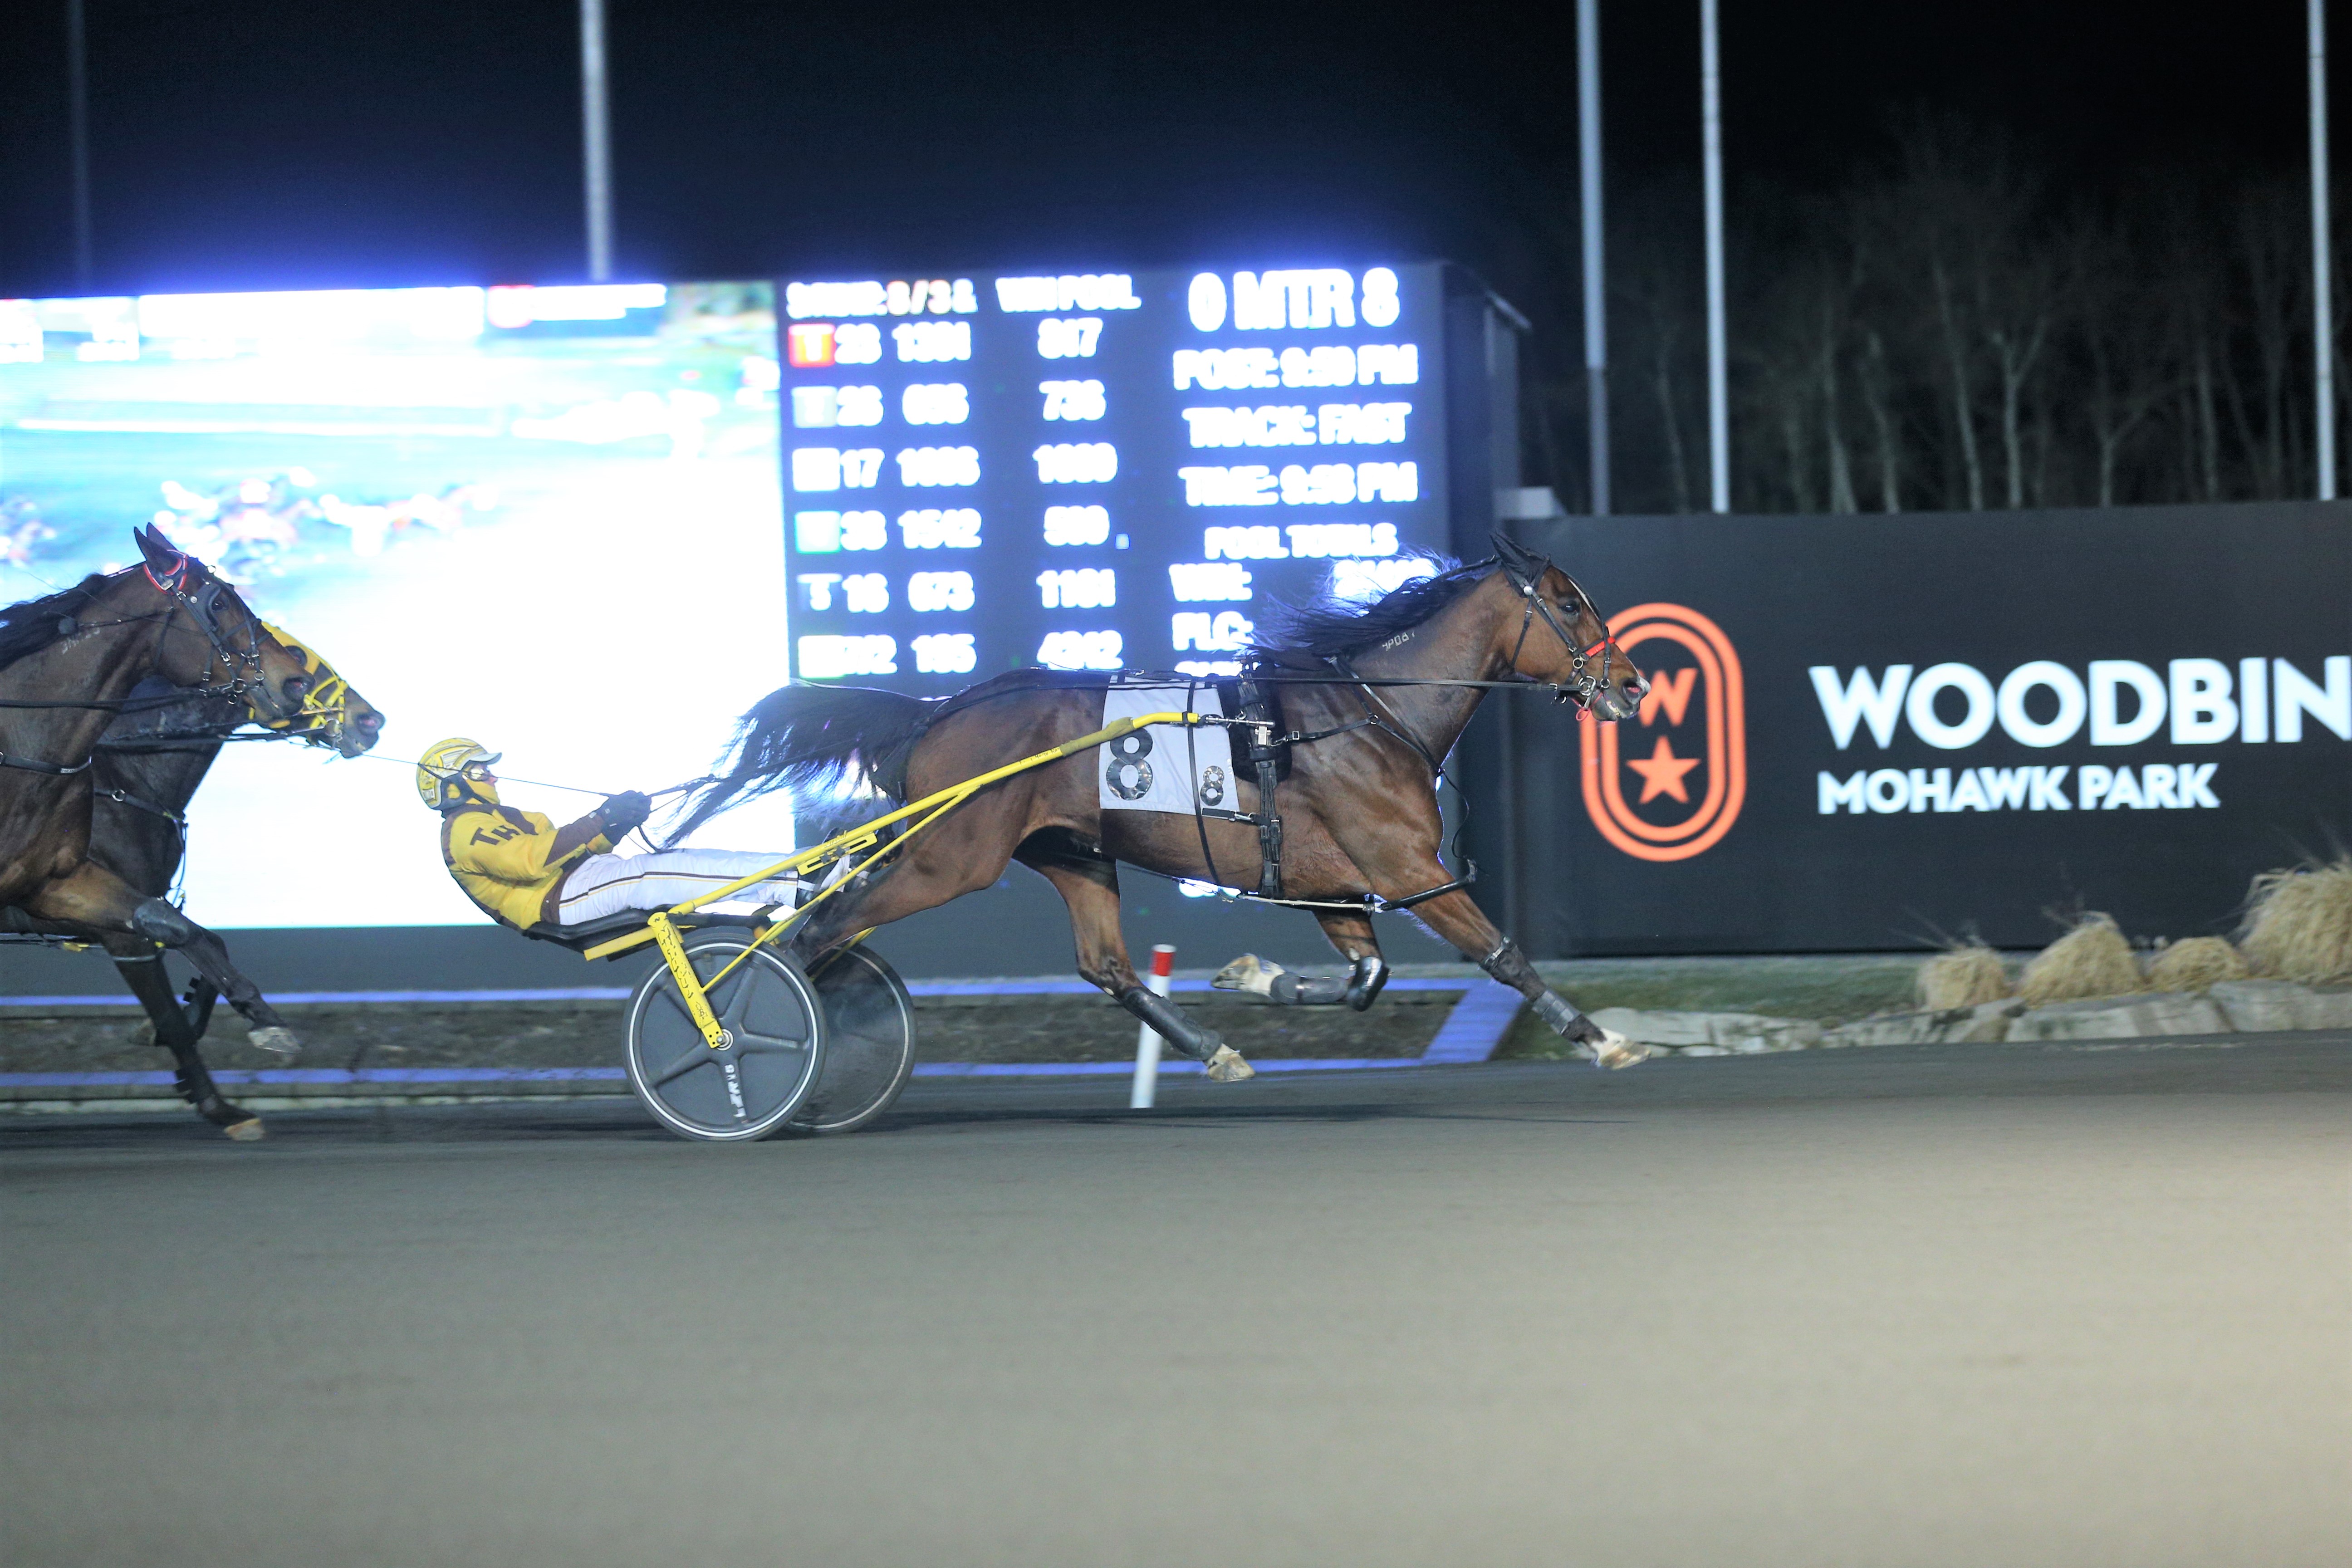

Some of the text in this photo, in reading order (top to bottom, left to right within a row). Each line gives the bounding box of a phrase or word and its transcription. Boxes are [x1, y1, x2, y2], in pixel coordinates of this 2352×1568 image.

[1361, 267, 1400, 327] 8
[1173, 348, 1280, 390] POST:
[1357, 344, 1418, 385] PM
[1318, 402, 1412, 444] FAST
[1178, 465, 1279, 506] TIME:
[1357, 462, 1418, 502] PM
[1808, 655, 2352, 750] WOODBIN
[1106, 727, 1153, 800] 8
[1200, 765, 1224, 806] 8
[1818, 763, 2220, 815] MOHAWK PARK
